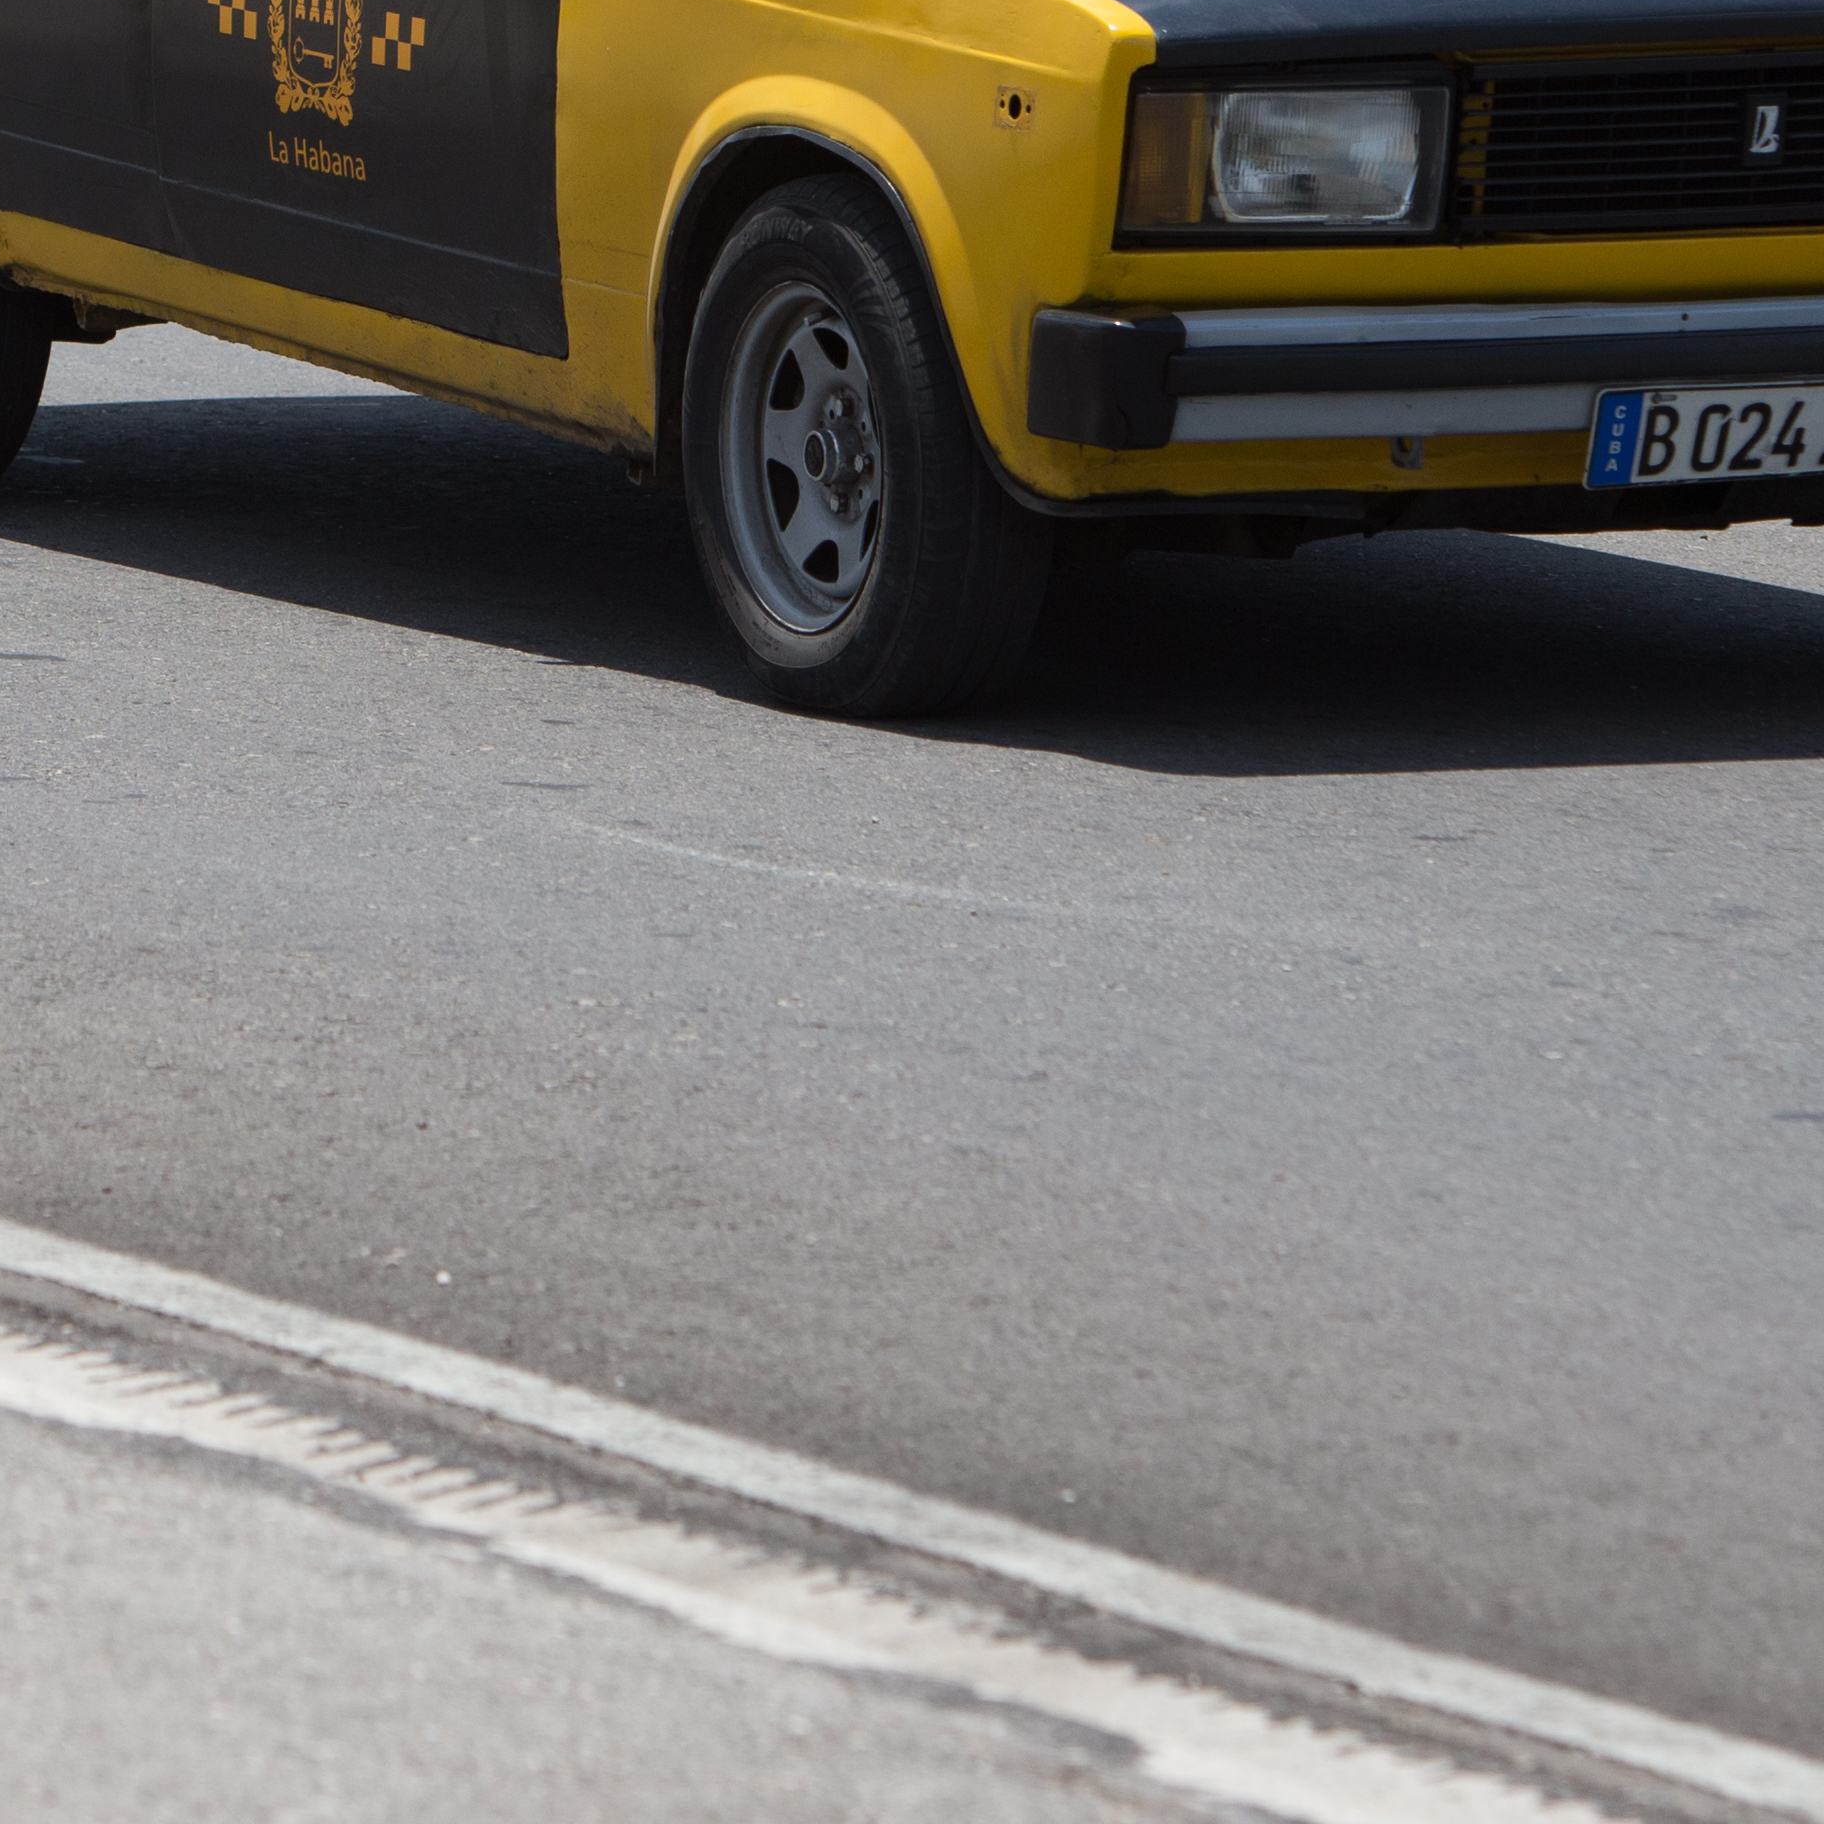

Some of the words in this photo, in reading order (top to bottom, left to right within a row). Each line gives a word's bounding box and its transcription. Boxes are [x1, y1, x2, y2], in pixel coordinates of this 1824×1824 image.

[268, 130, 289, 164] La
[294, 136, 367, 182] Habana
[1604, 404, 1628, 472] CUBA
[1638, 405, 1679, 476] B
[1690, 400, 1806, 473] 024
